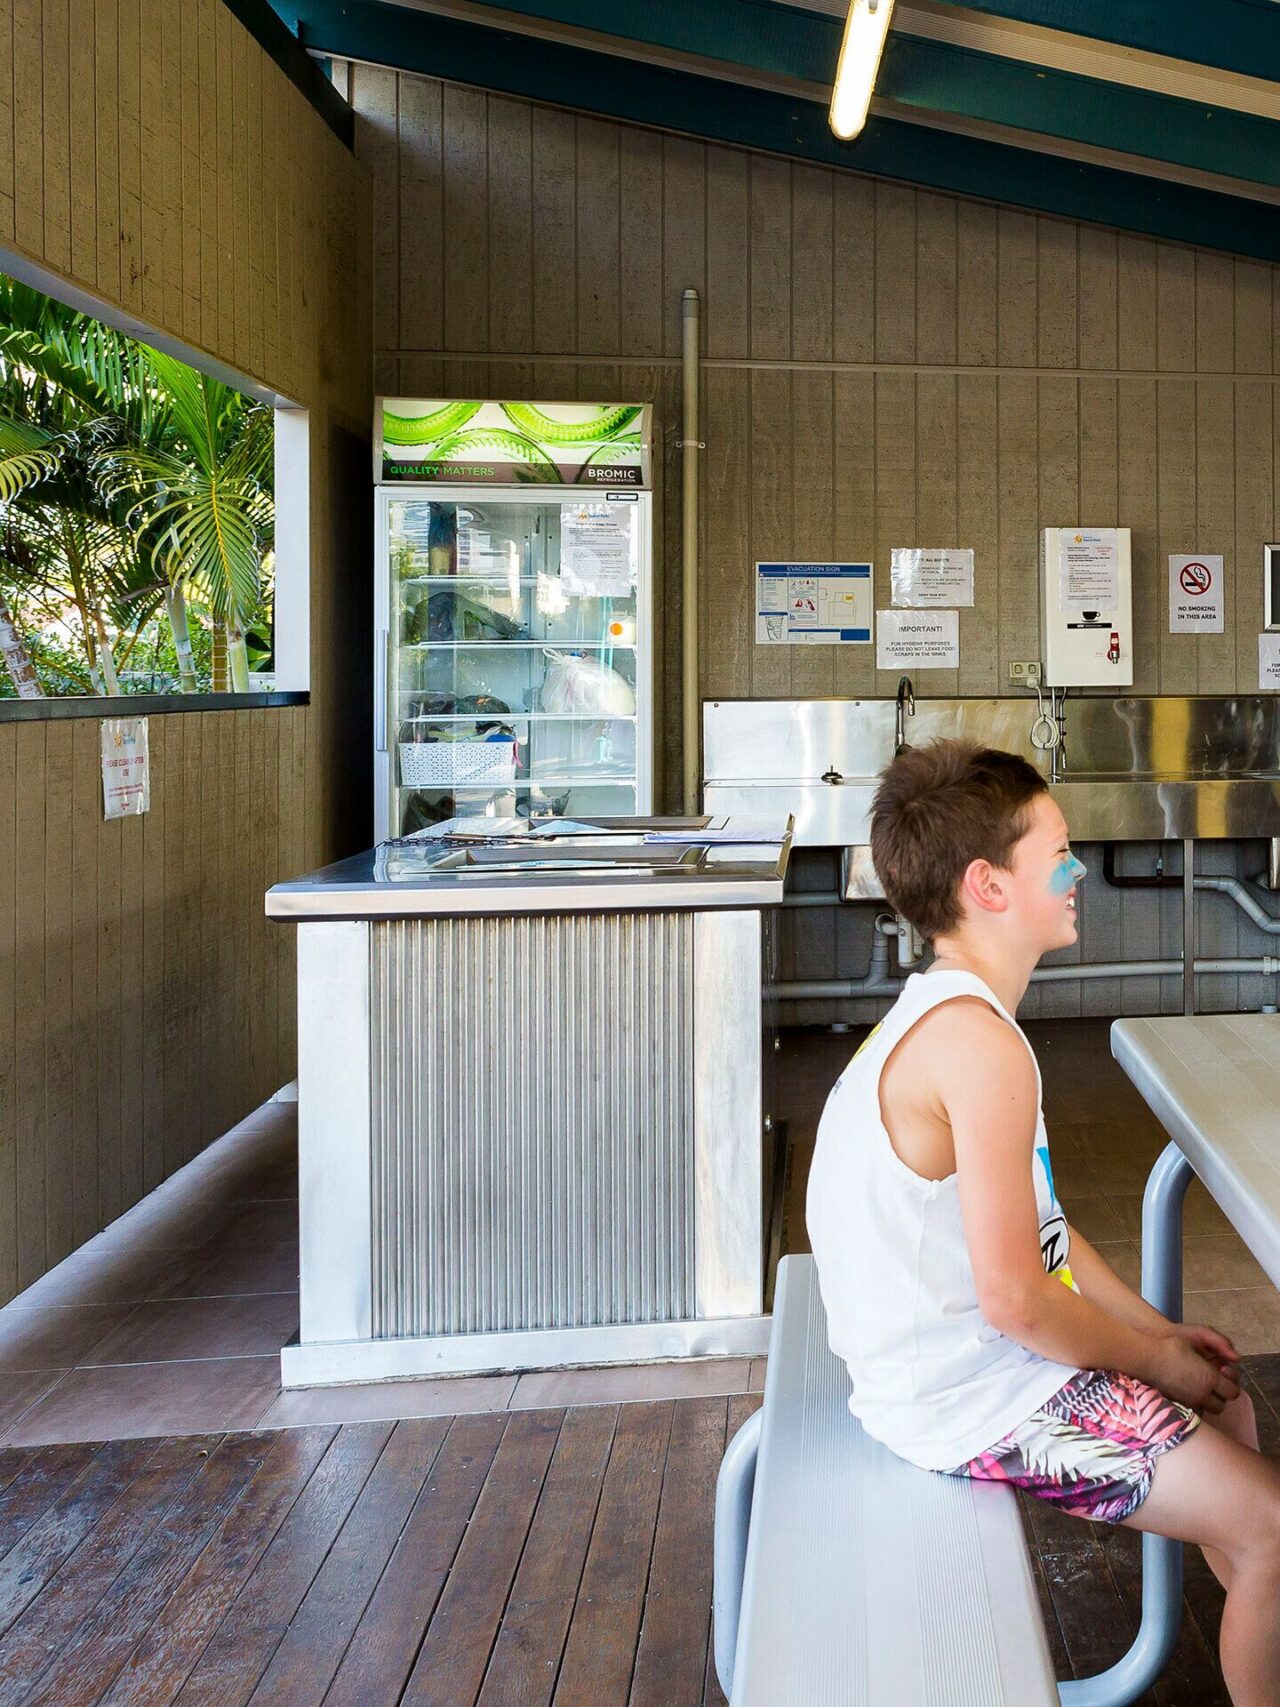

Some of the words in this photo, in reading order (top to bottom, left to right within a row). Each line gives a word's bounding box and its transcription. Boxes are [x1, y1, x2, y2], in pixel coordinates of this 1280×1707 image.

[390, 466, 439, 475] QUALITY
[443, 467, 495, 476] MATTERS
[588, 468, 636, 479] BROMIC
[899, 625, 943, 633] IMPORTANT!
